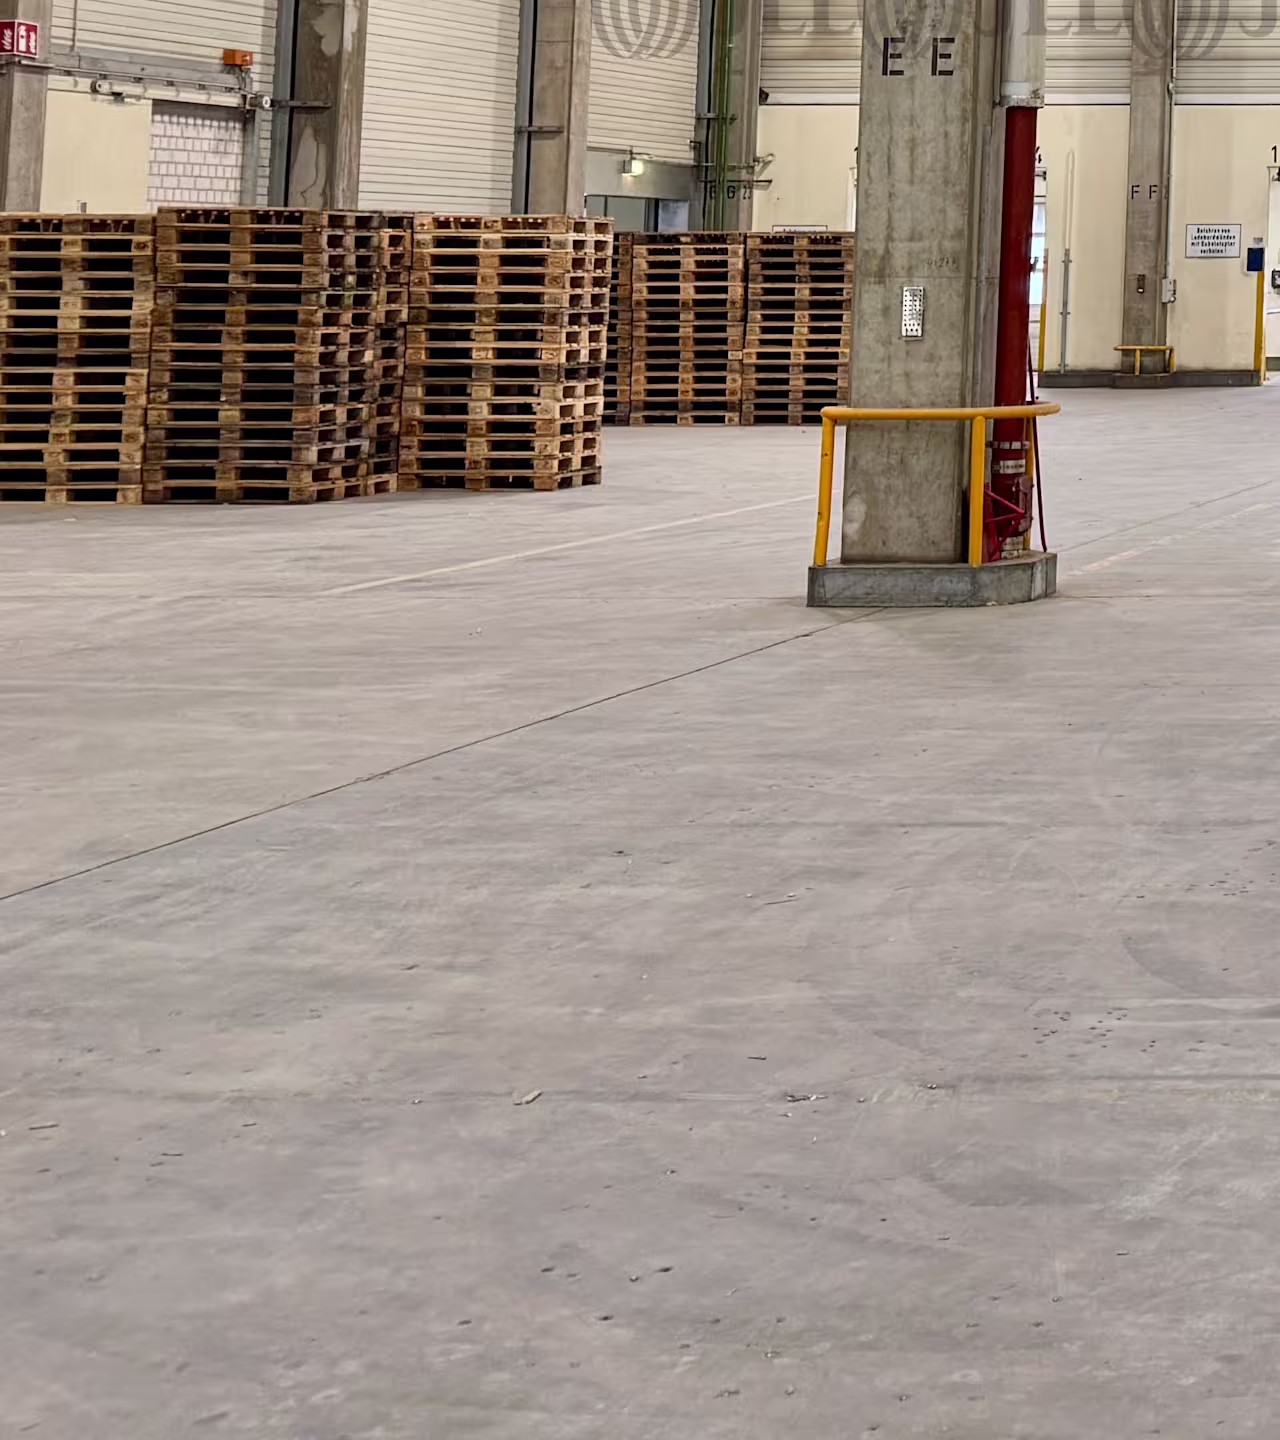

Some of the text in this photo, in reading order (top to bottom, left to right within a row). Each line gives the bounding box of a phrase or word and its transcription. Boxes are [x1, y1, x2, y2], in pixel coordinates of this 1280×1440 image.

[881, 37, 954, 76] E E
[1131, 185, 1140, 199] F
[1149, 185, 1158, 199] F
